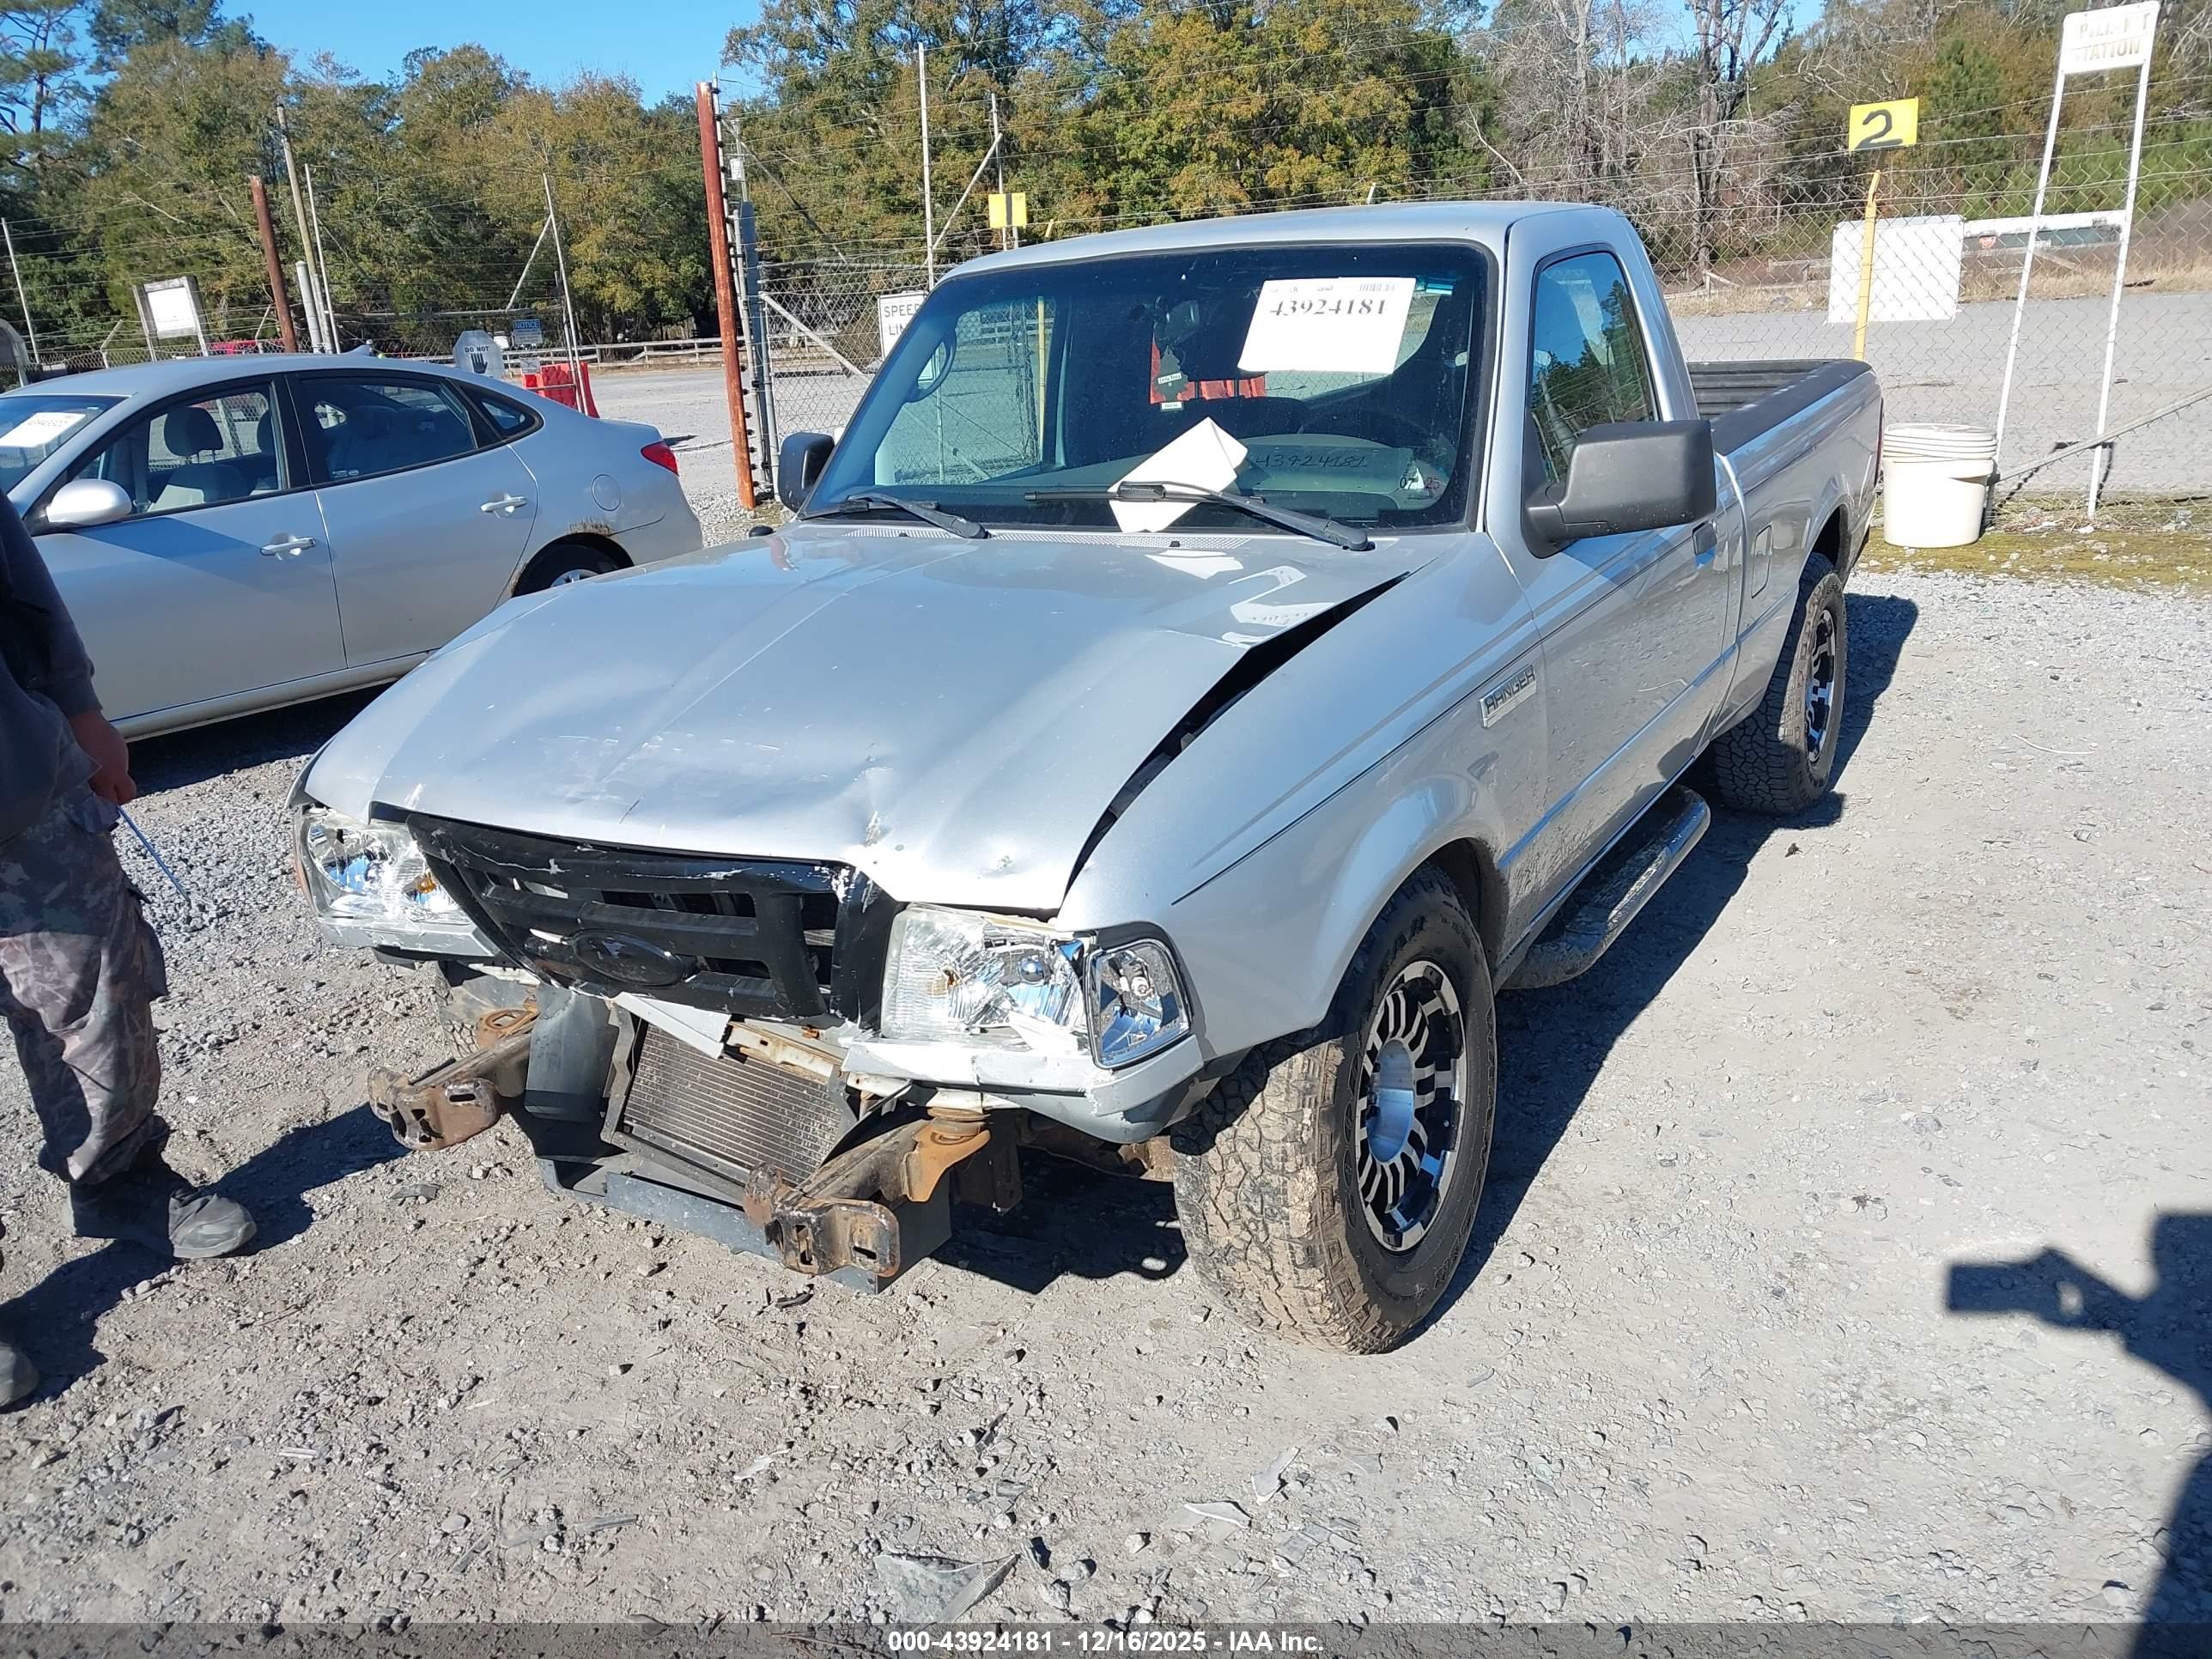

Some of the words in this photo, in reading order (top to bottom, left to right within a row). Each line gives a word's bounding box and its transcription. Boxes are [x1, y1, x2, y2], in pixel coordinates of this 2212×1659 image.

[2074, 39, 2142, 61] TATION
[1855, 109, 1903, 149] 2
[1270, 298, 1385, 316] 43924181
[515, 321, 539, 330] NOTICE
[1484, 665, 1535, 714] RANGER
